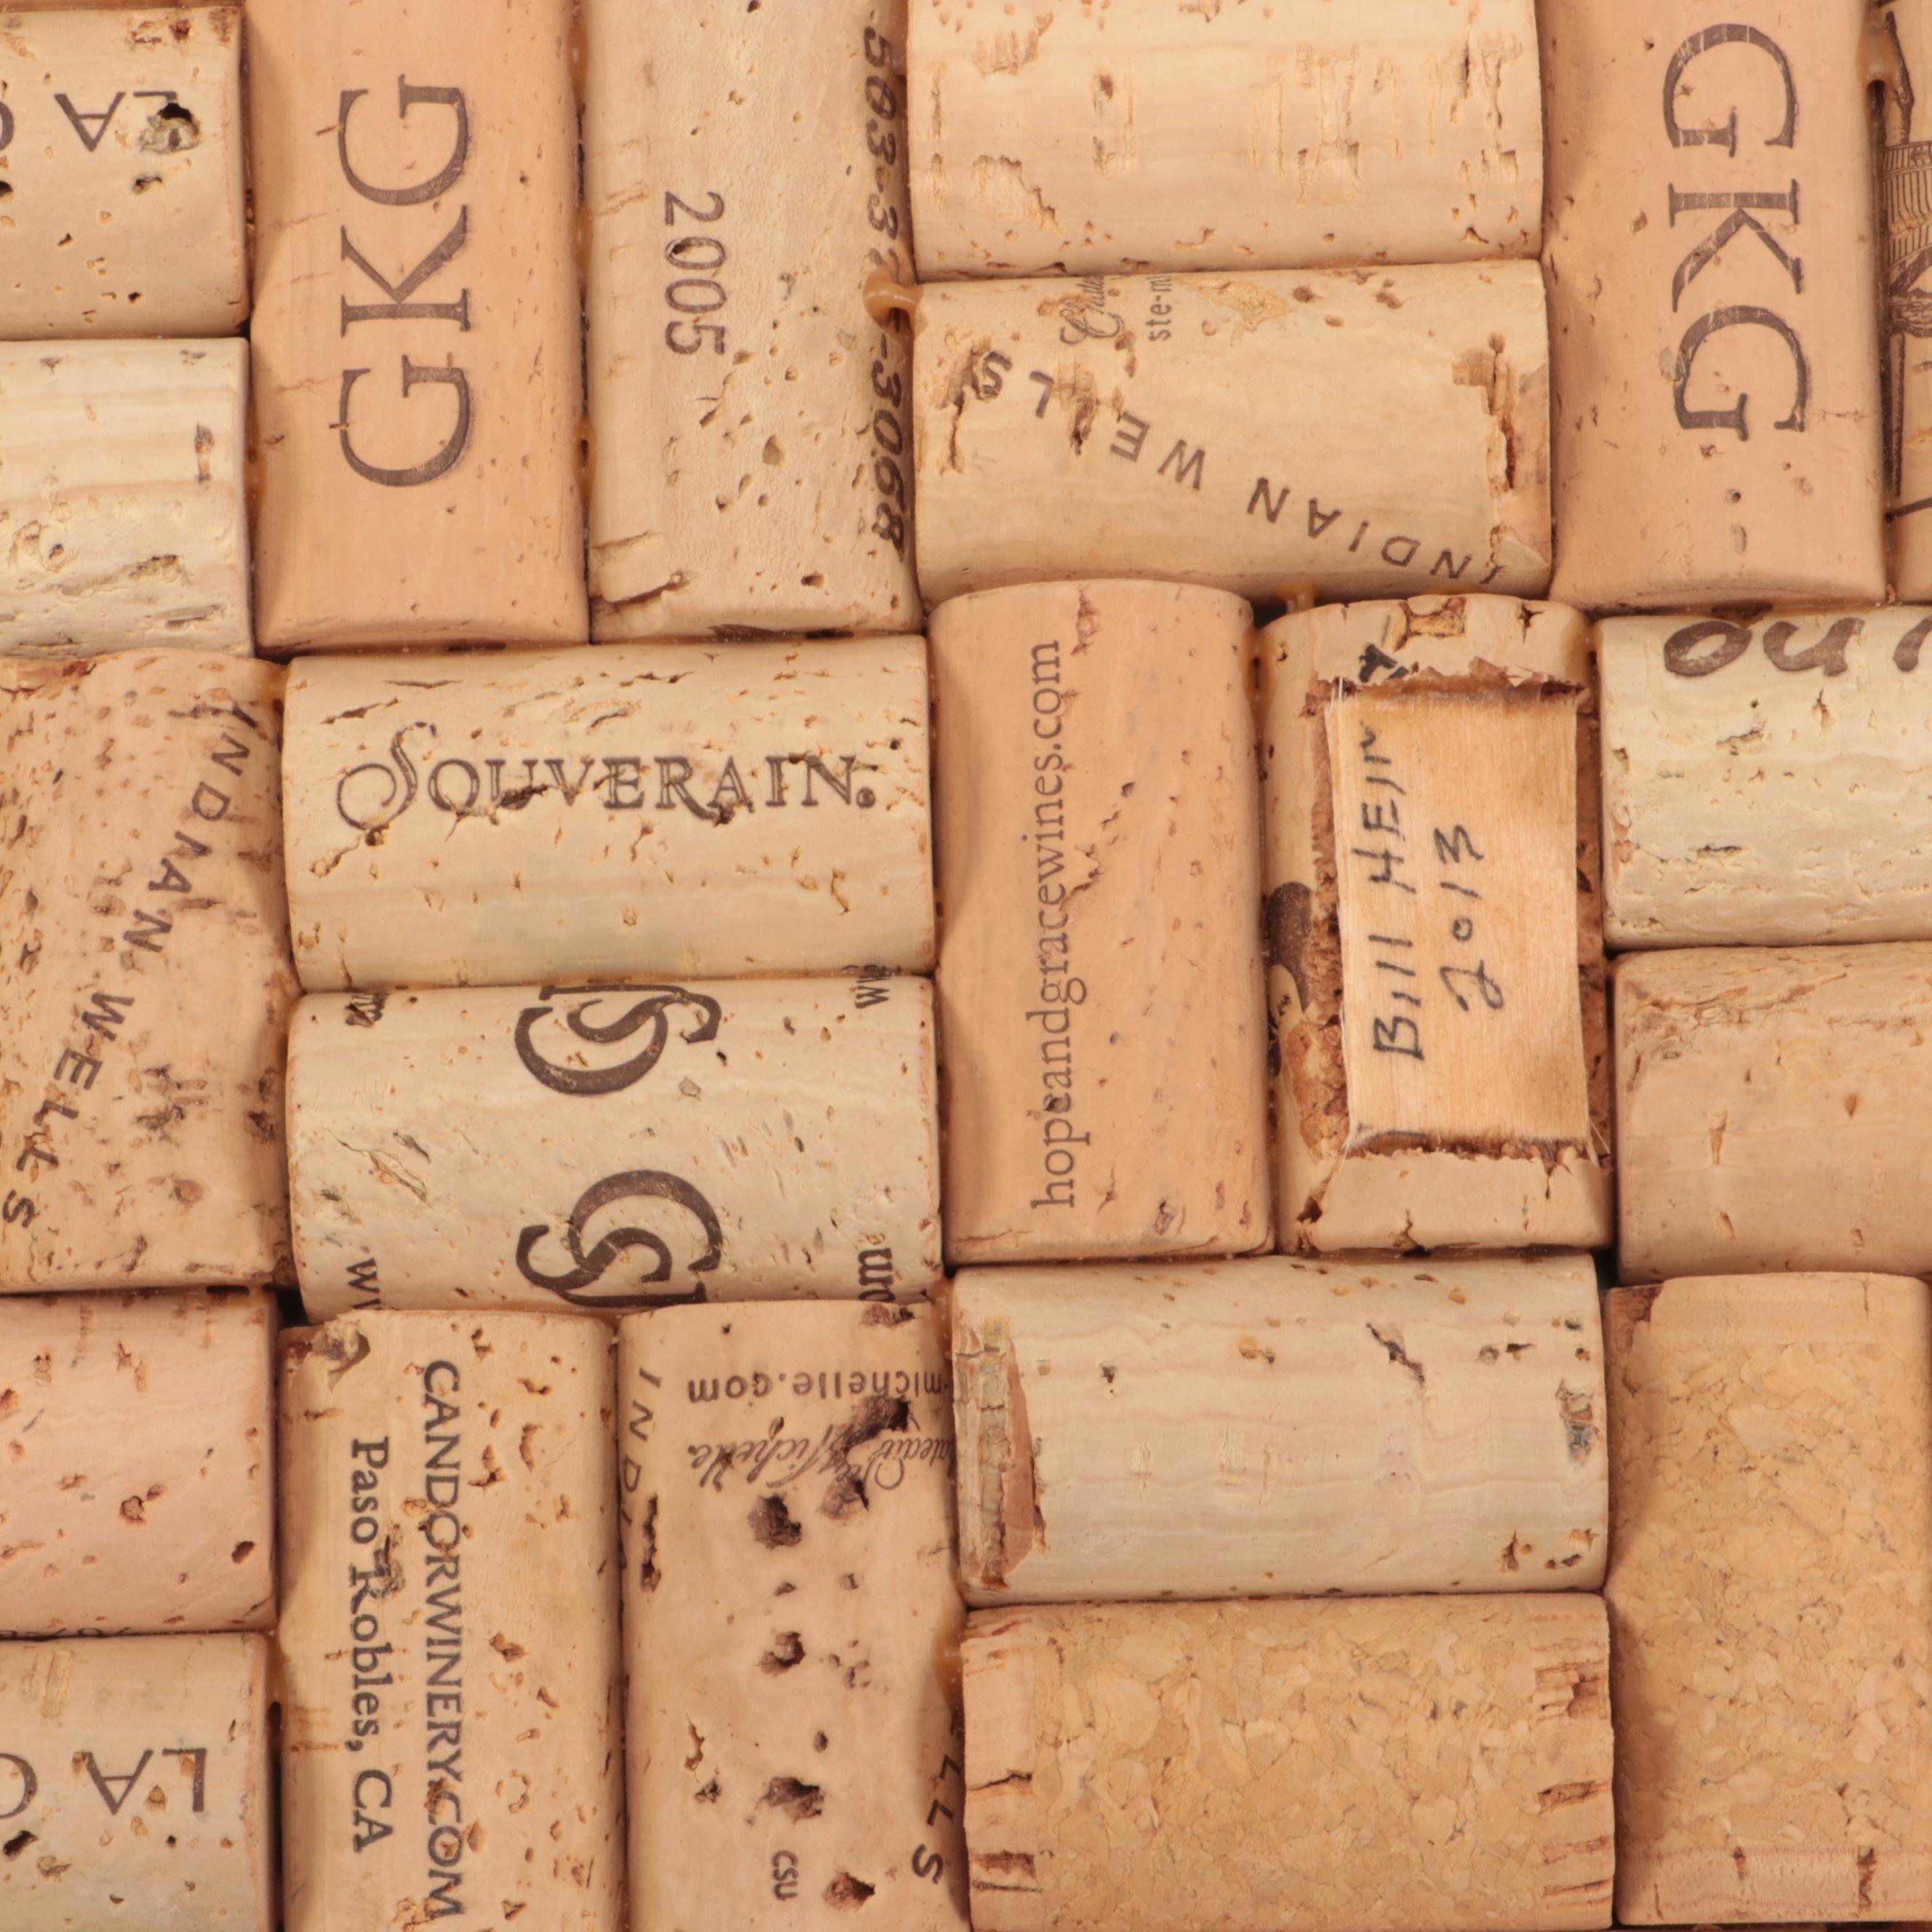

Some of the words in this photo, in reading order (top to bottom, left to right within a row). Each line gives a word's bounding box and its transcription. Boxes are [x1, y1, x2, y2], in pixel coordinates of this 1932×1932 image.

[338, 74, 471, 487] GKG
[663, 190, 727, 357] 2005
[1662, 23, 1812, 442] GKG
[982, 351, 1205, 490] WELS
[122, 704, 259, 953] INDIAN
[1433, 825, 1504, 1010] 2013
[1022, 639, 1090, 1209] hopeandgracewines.com
[2, 992, 135, 1228] WELLS
[351, 1434, 390, 1545] Paso
[344, 1558, 394, 1752] Robles,
[423, 1359, 466, 1918] CANDORWINERY.COM
[81, 1747, 207, 1817] LA
[352, 1768, 394, 1854] CA
[772, 1850, 799, 1902] CSU
